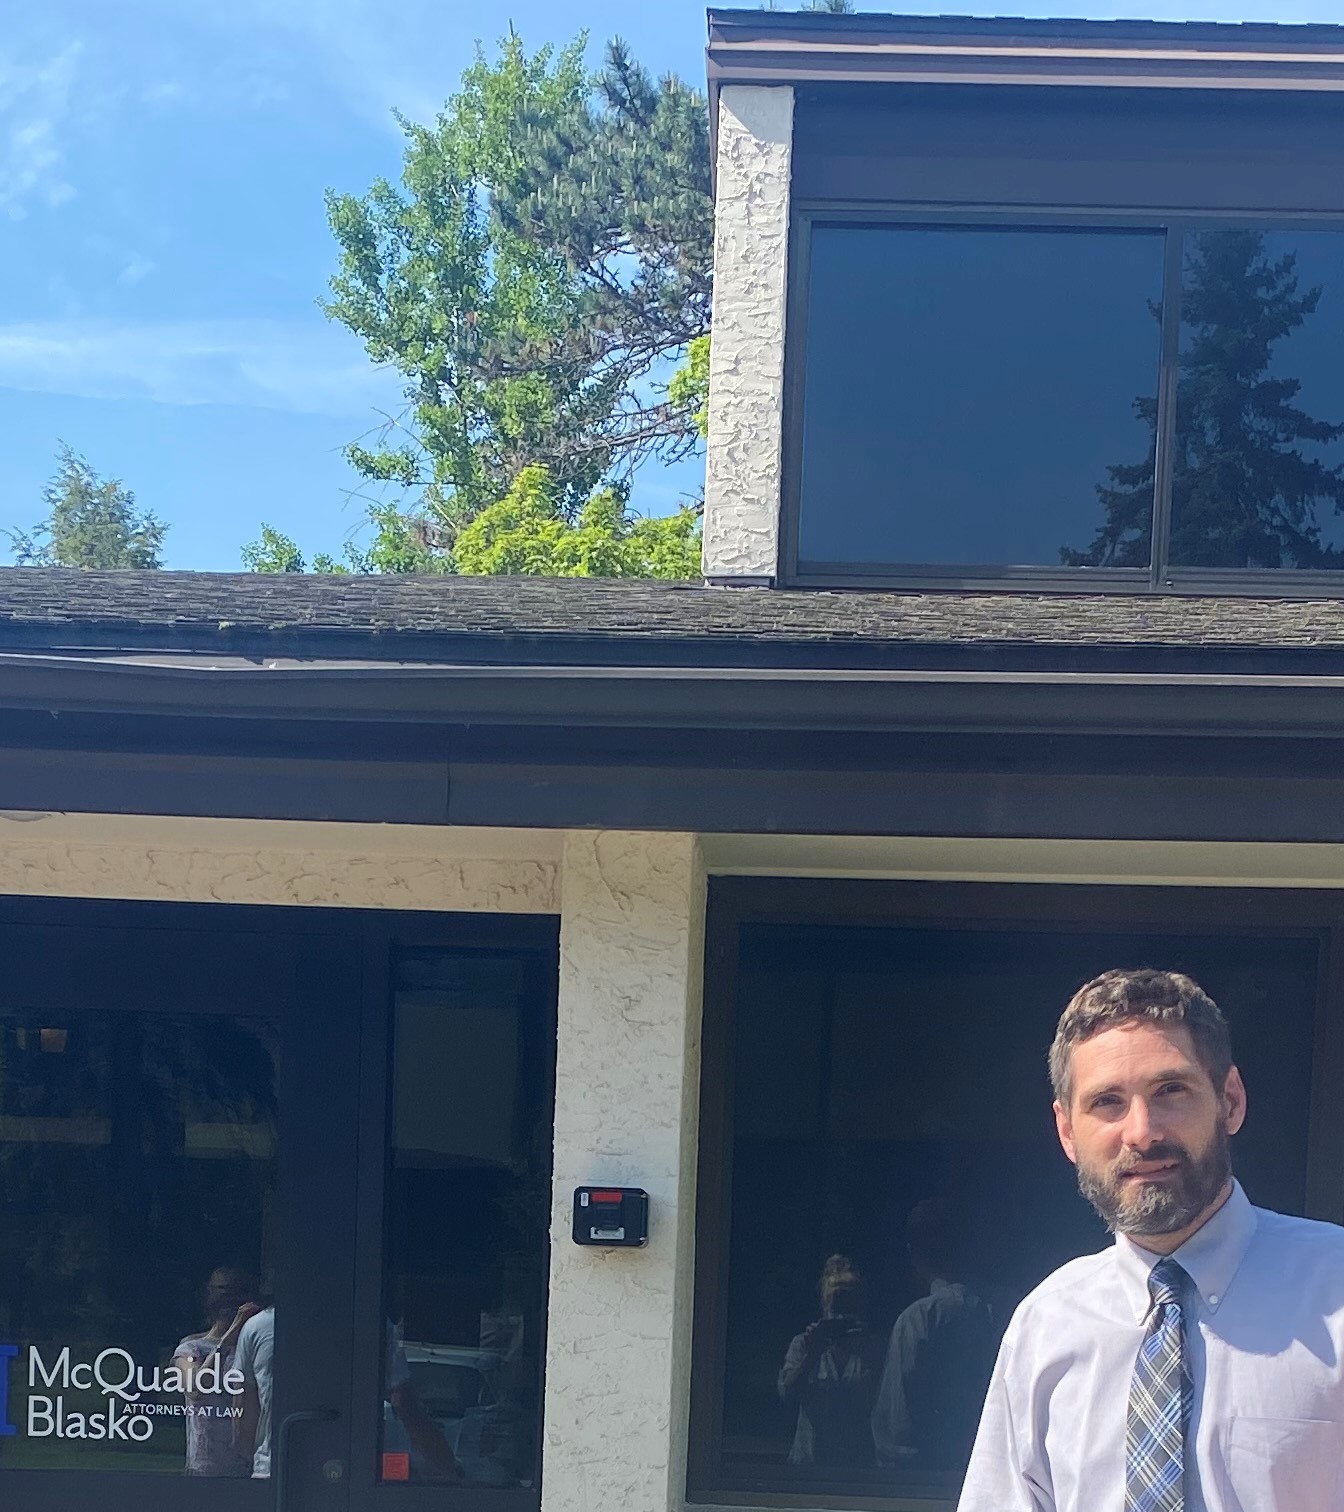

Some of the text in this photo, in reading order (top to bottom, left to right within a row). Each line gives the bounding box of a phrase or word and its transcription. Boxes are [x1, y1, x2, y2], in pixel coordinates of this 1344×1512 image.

[28, 1345, 245, 1401] McQuaide
[27, 1395, 153, 1441] Blasko
[123, 1403, 244, 1418] ATTORNEYS AT LAW
